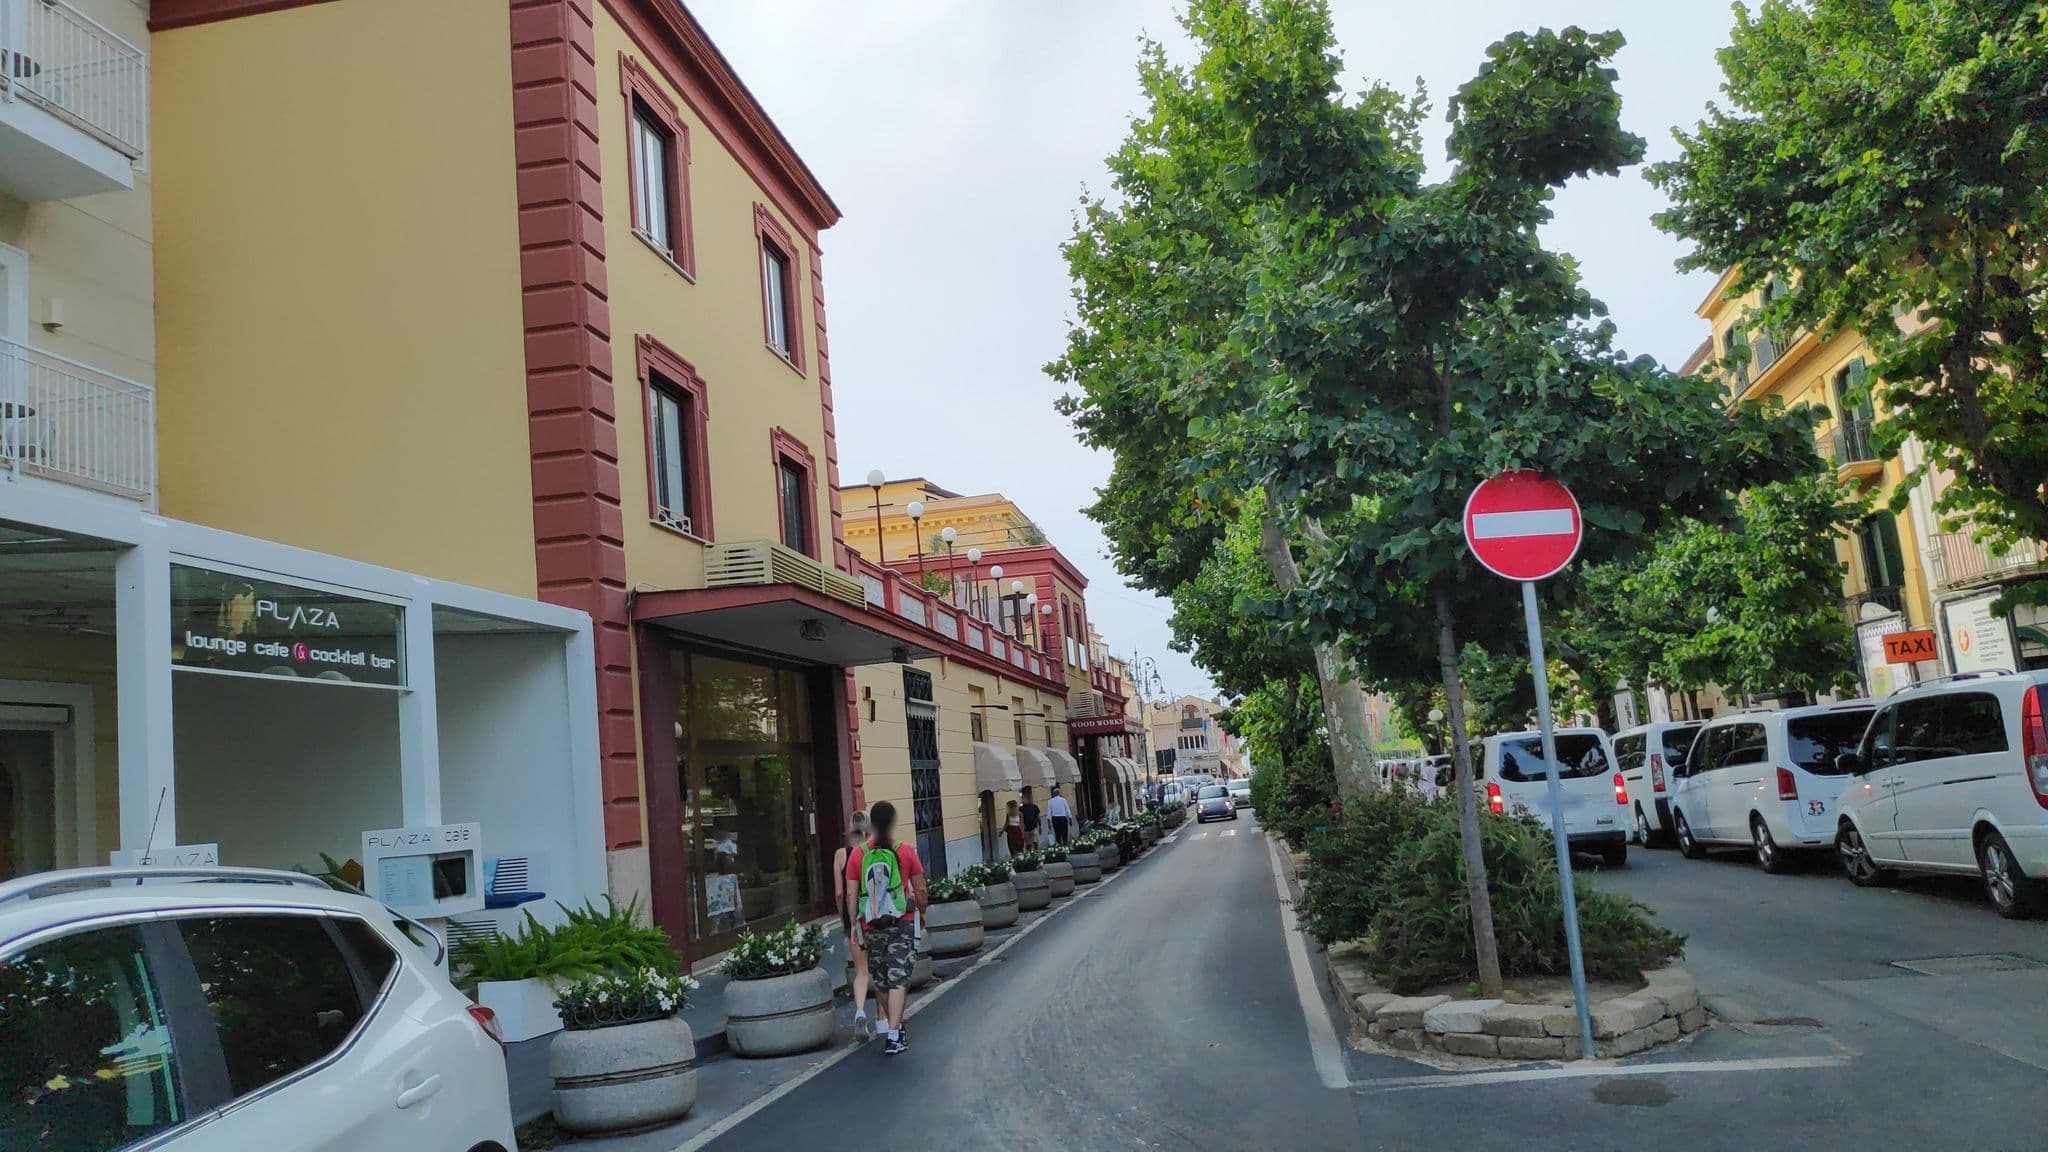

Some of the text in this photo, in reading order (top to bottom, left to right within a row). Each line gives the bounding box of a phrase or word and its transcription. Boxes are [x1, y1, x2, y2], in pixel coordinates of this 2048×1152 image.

[256, 599, 340, 630] PLAZA
[185, 630, 247, 656] lounge
[254, 642, 289, 658] cafe
[310, 648, 366, 666] cocktail
[371, 653, 396, 670] bar
[1887, 637, 1933, 657] TAXI
[1097, 718, 1124, 726] WORKS
[368, 834, 432, 849] PLAZA
